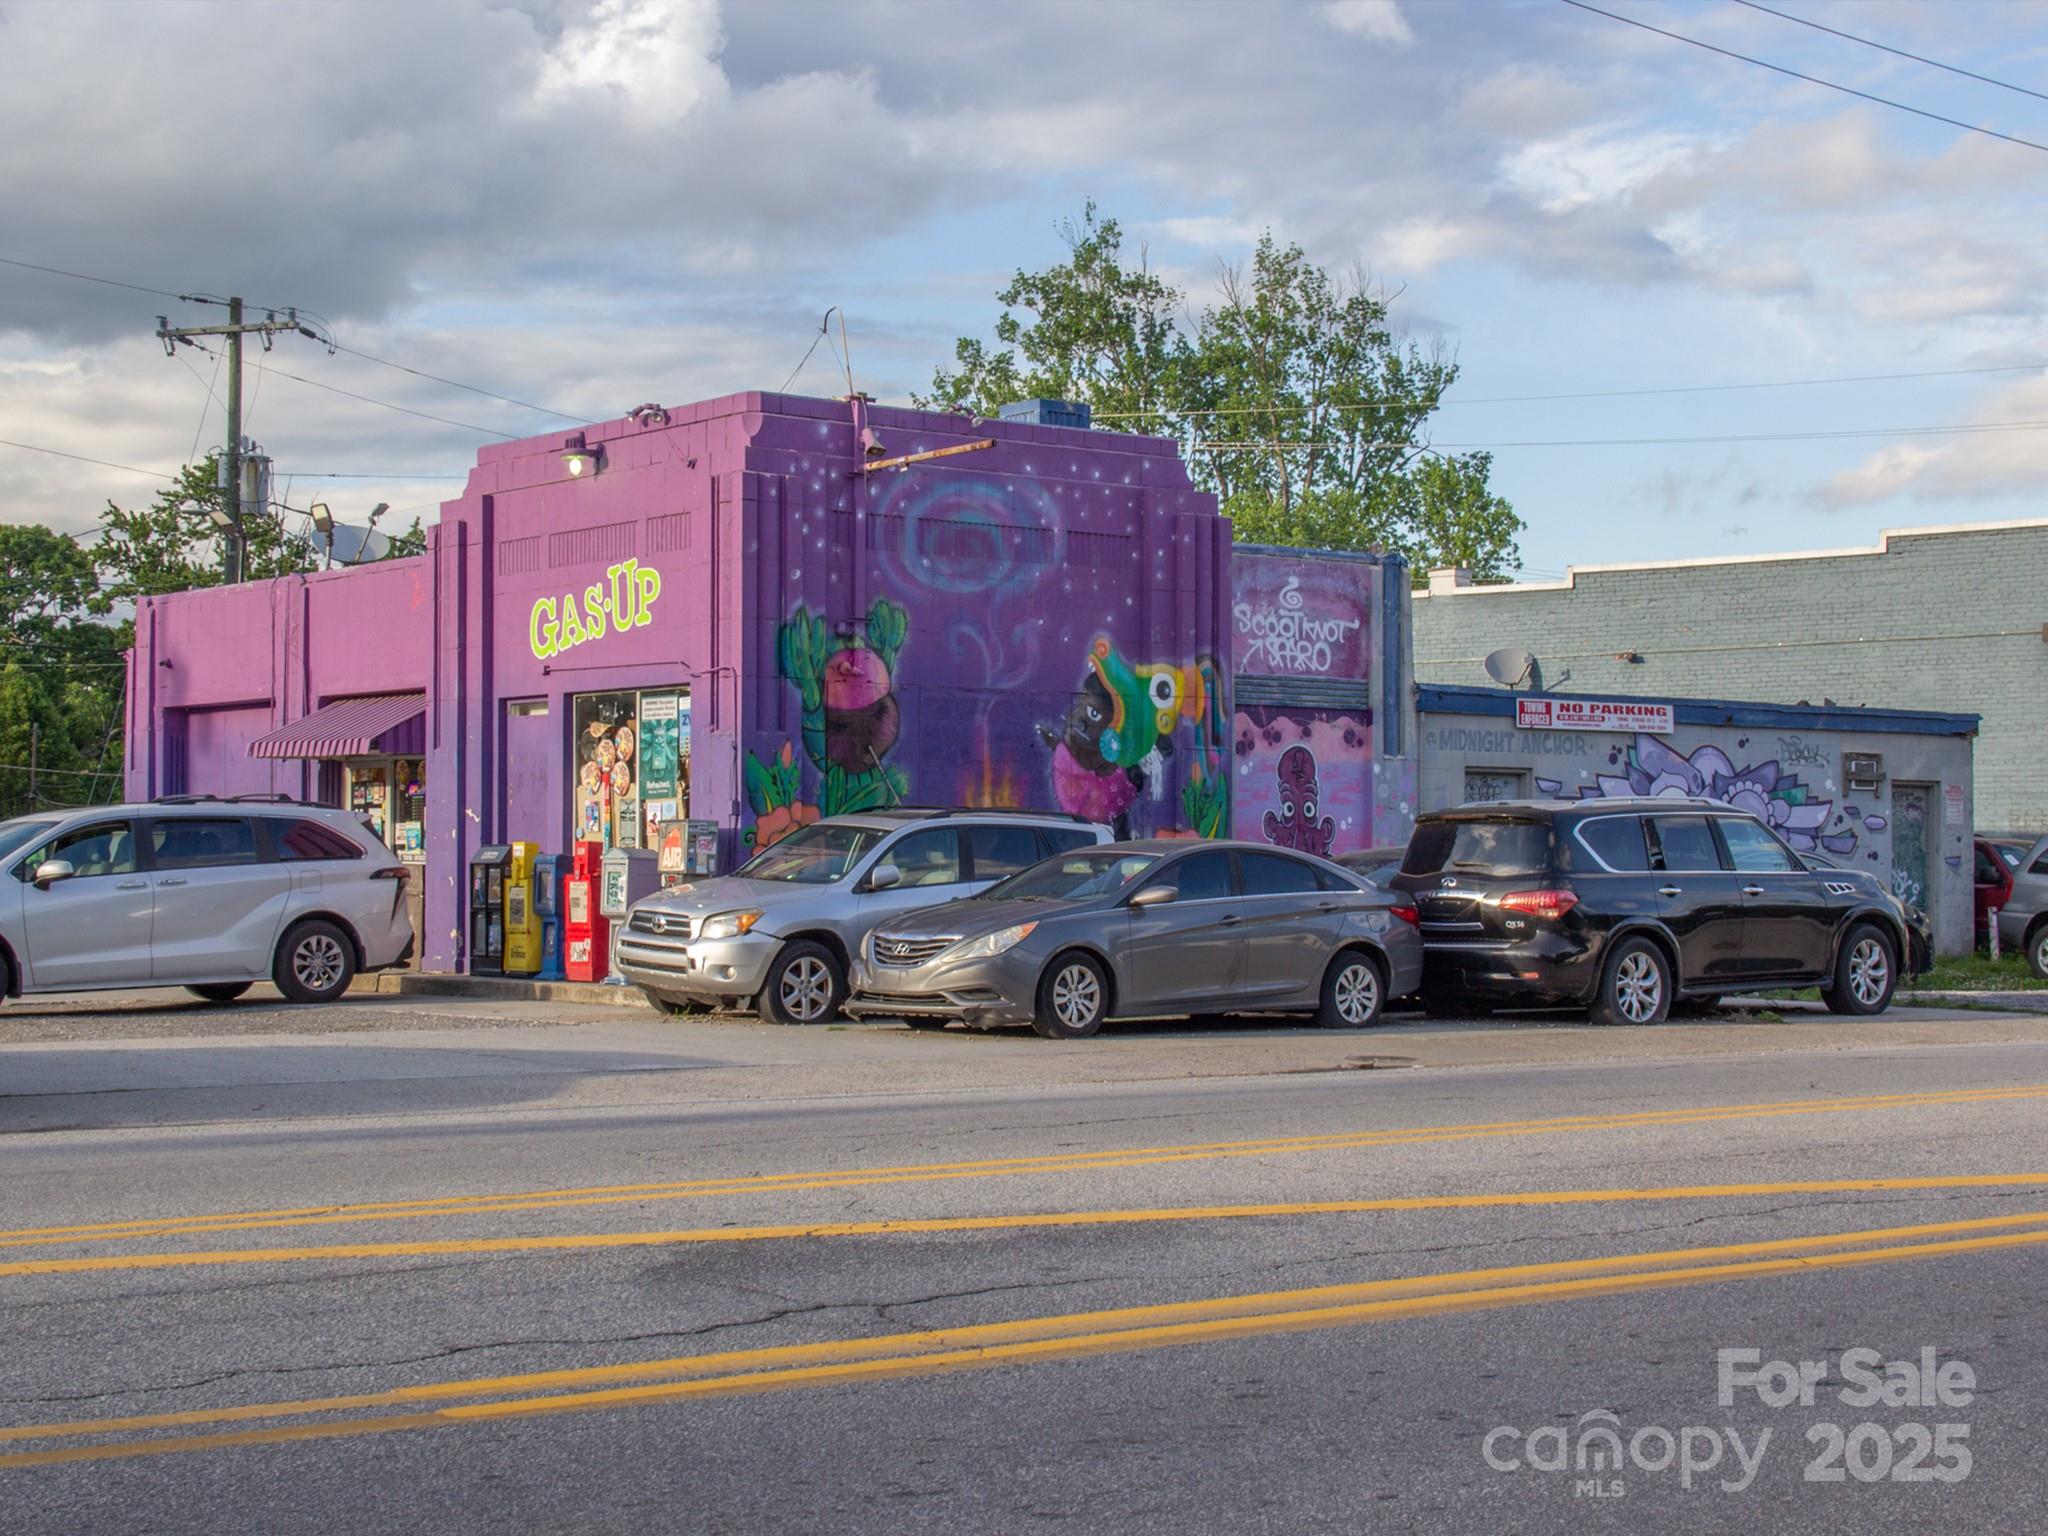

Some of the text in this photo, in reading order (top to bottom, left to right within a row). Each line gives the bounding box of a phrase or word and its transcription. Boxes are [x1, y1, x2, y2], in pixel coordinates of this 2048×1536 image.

[1523, 701, 1547, 713] TOWING
[1559, 702, 1668, 717] NO PARKING
[1439, 728, 1515, 752] MIDNIGHT
[1520, 732, 1588, 755] ANCHOR
[662, 846, 682, 868] AIR
